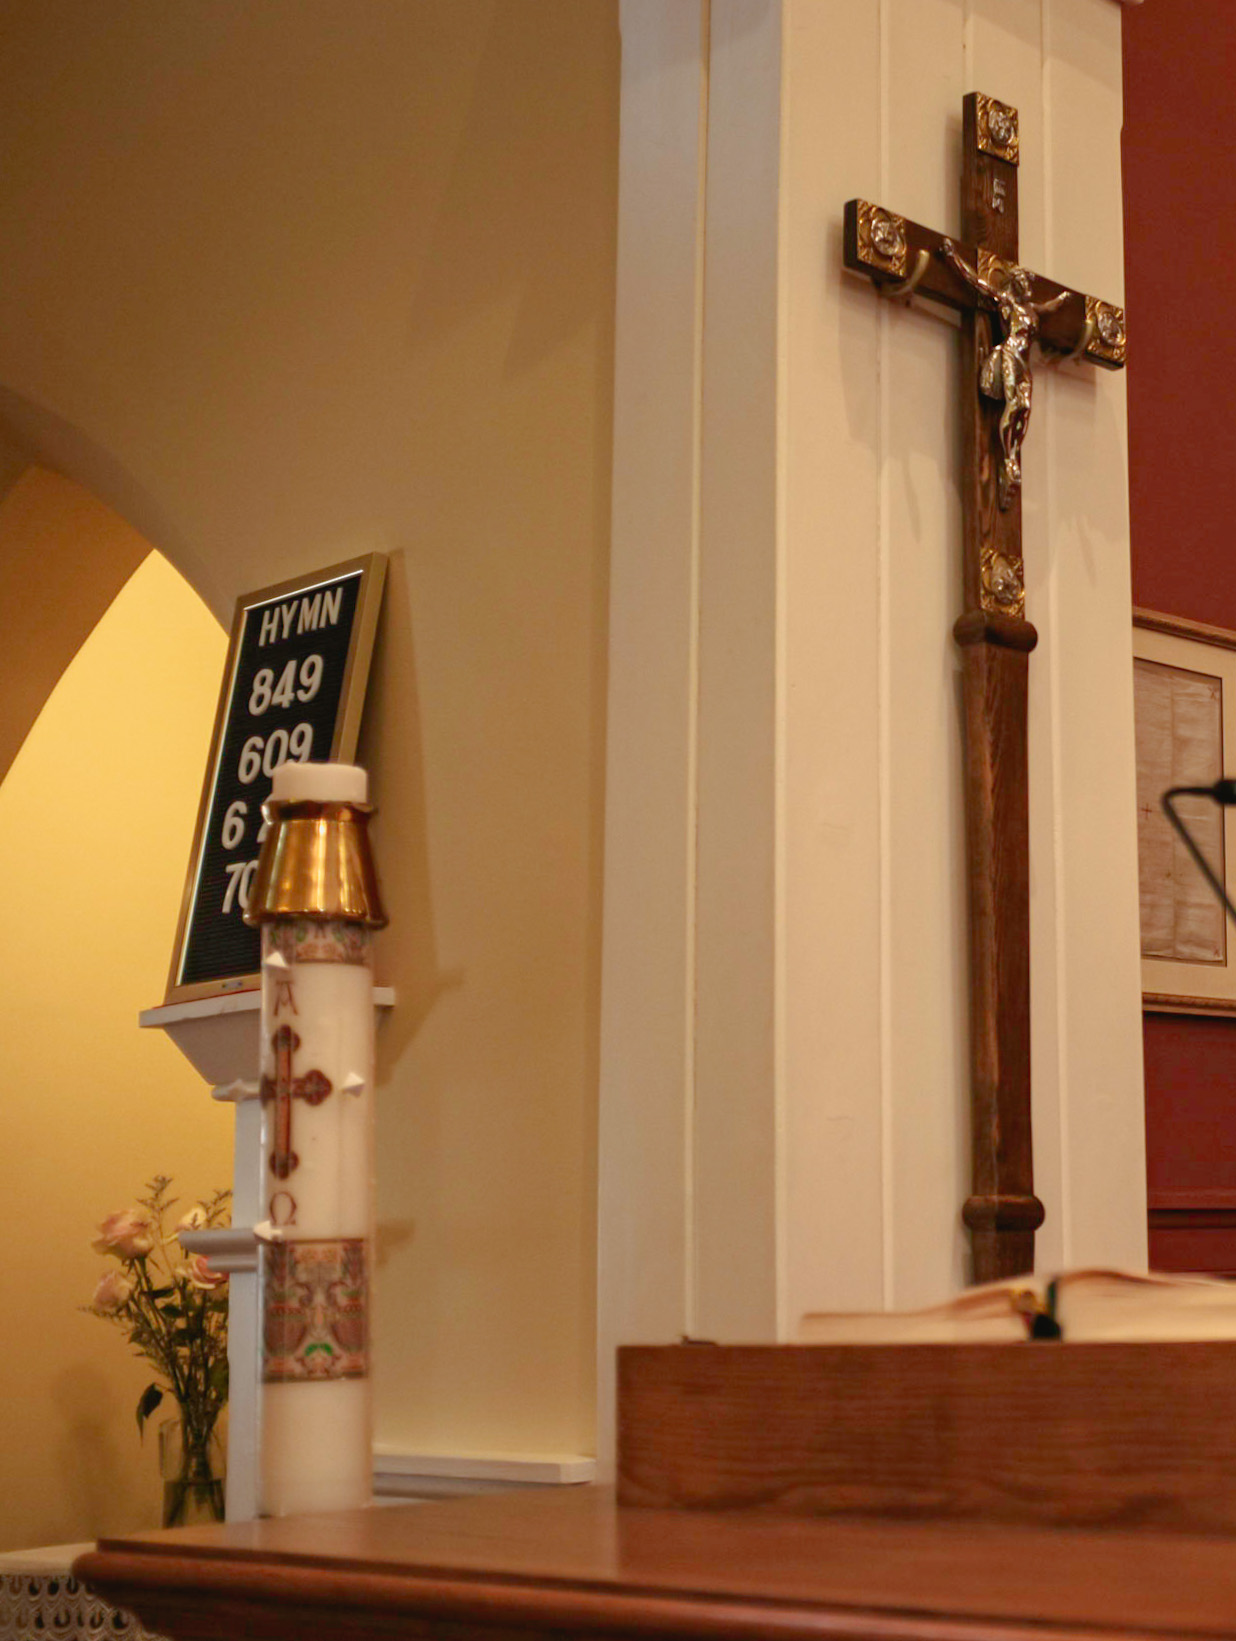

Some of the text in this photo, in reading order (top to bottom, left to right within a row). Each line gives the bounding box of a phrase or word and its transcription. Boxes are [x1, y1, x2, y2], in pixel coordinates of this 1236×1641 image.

[258, 586, 344, 647] HYMN
[248, 653, 324, 717] 849
[237, 722, 314, 785] 609
